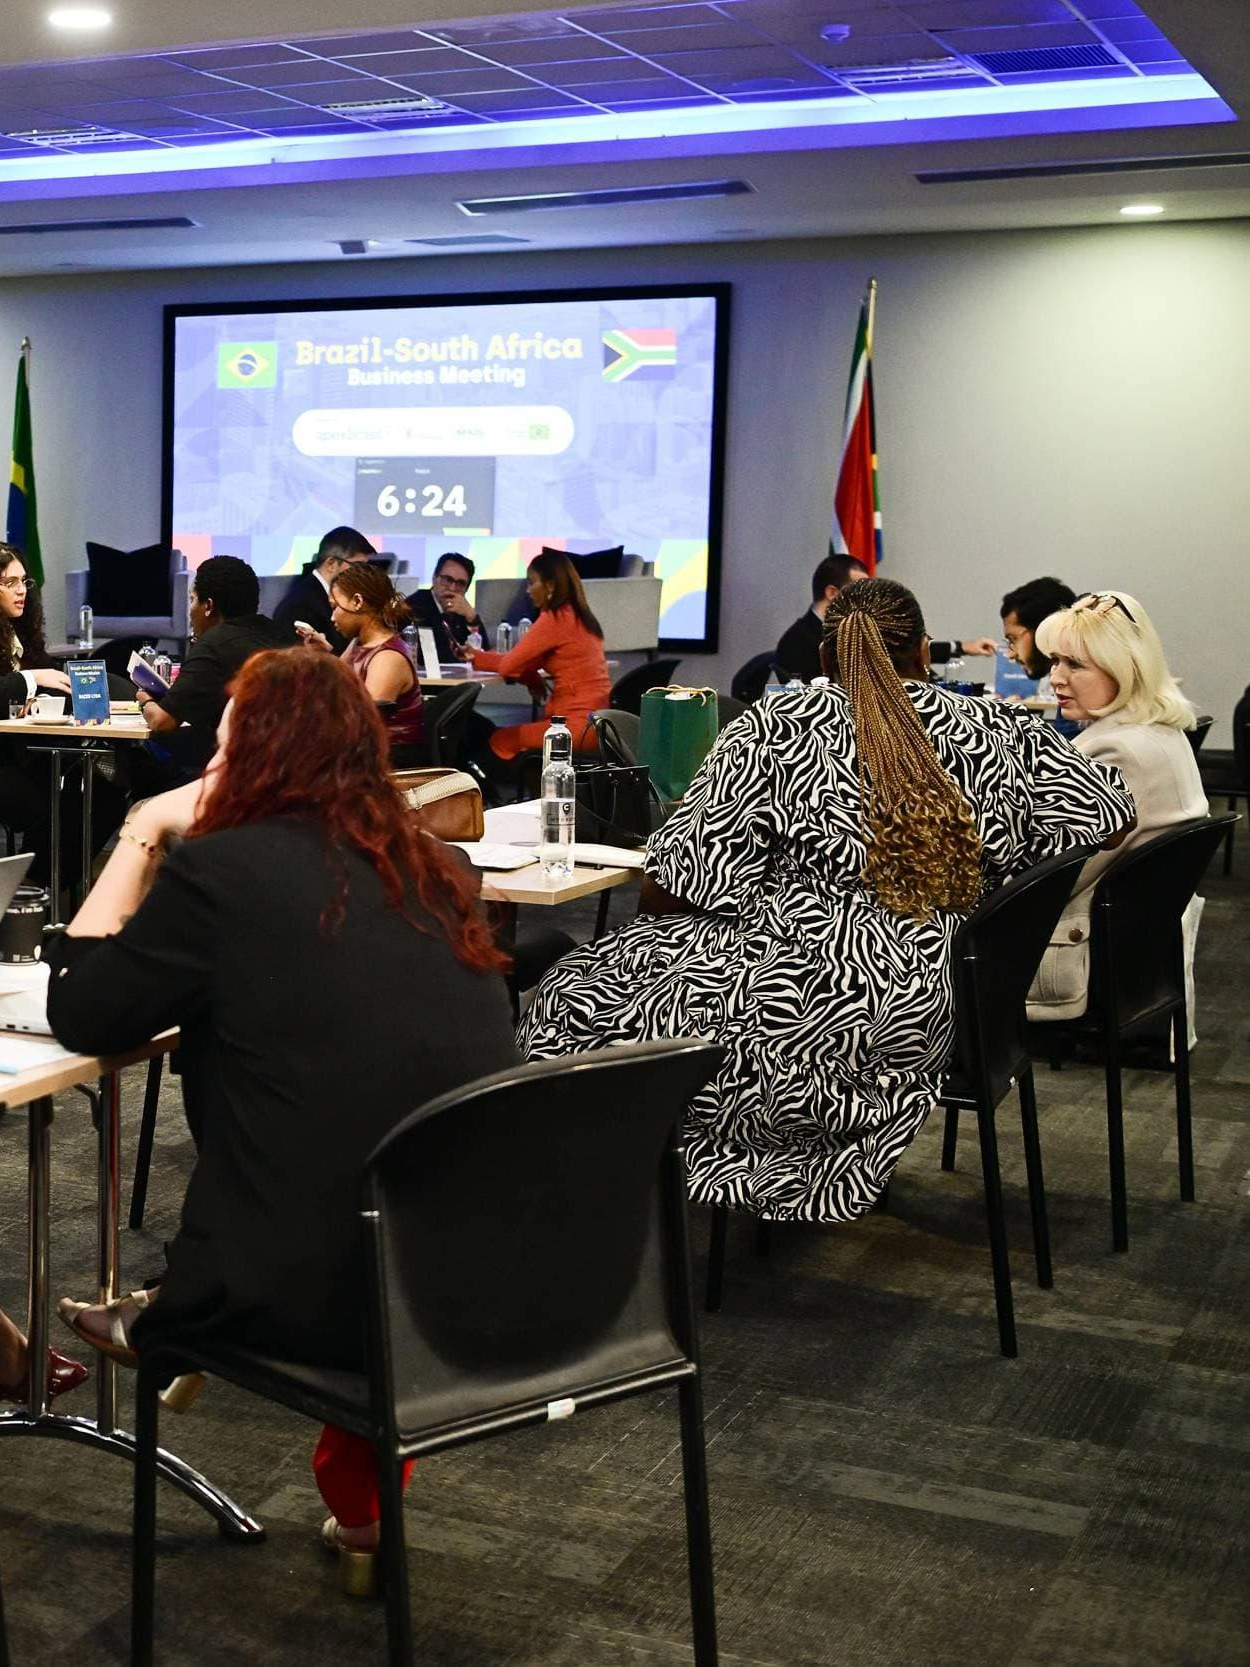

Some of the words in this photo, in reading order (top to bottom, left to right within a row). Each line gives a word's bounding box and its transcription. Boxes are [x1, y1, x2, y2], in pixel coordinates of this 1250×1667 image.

[295, 334, 478, 365] Brazil-South
[485, 332, 583, 360] Africa
[347, 366, 434, 386] Business
[439, 364, 526, 388] Meeting
[377, 484, 467, 517] 6:24
